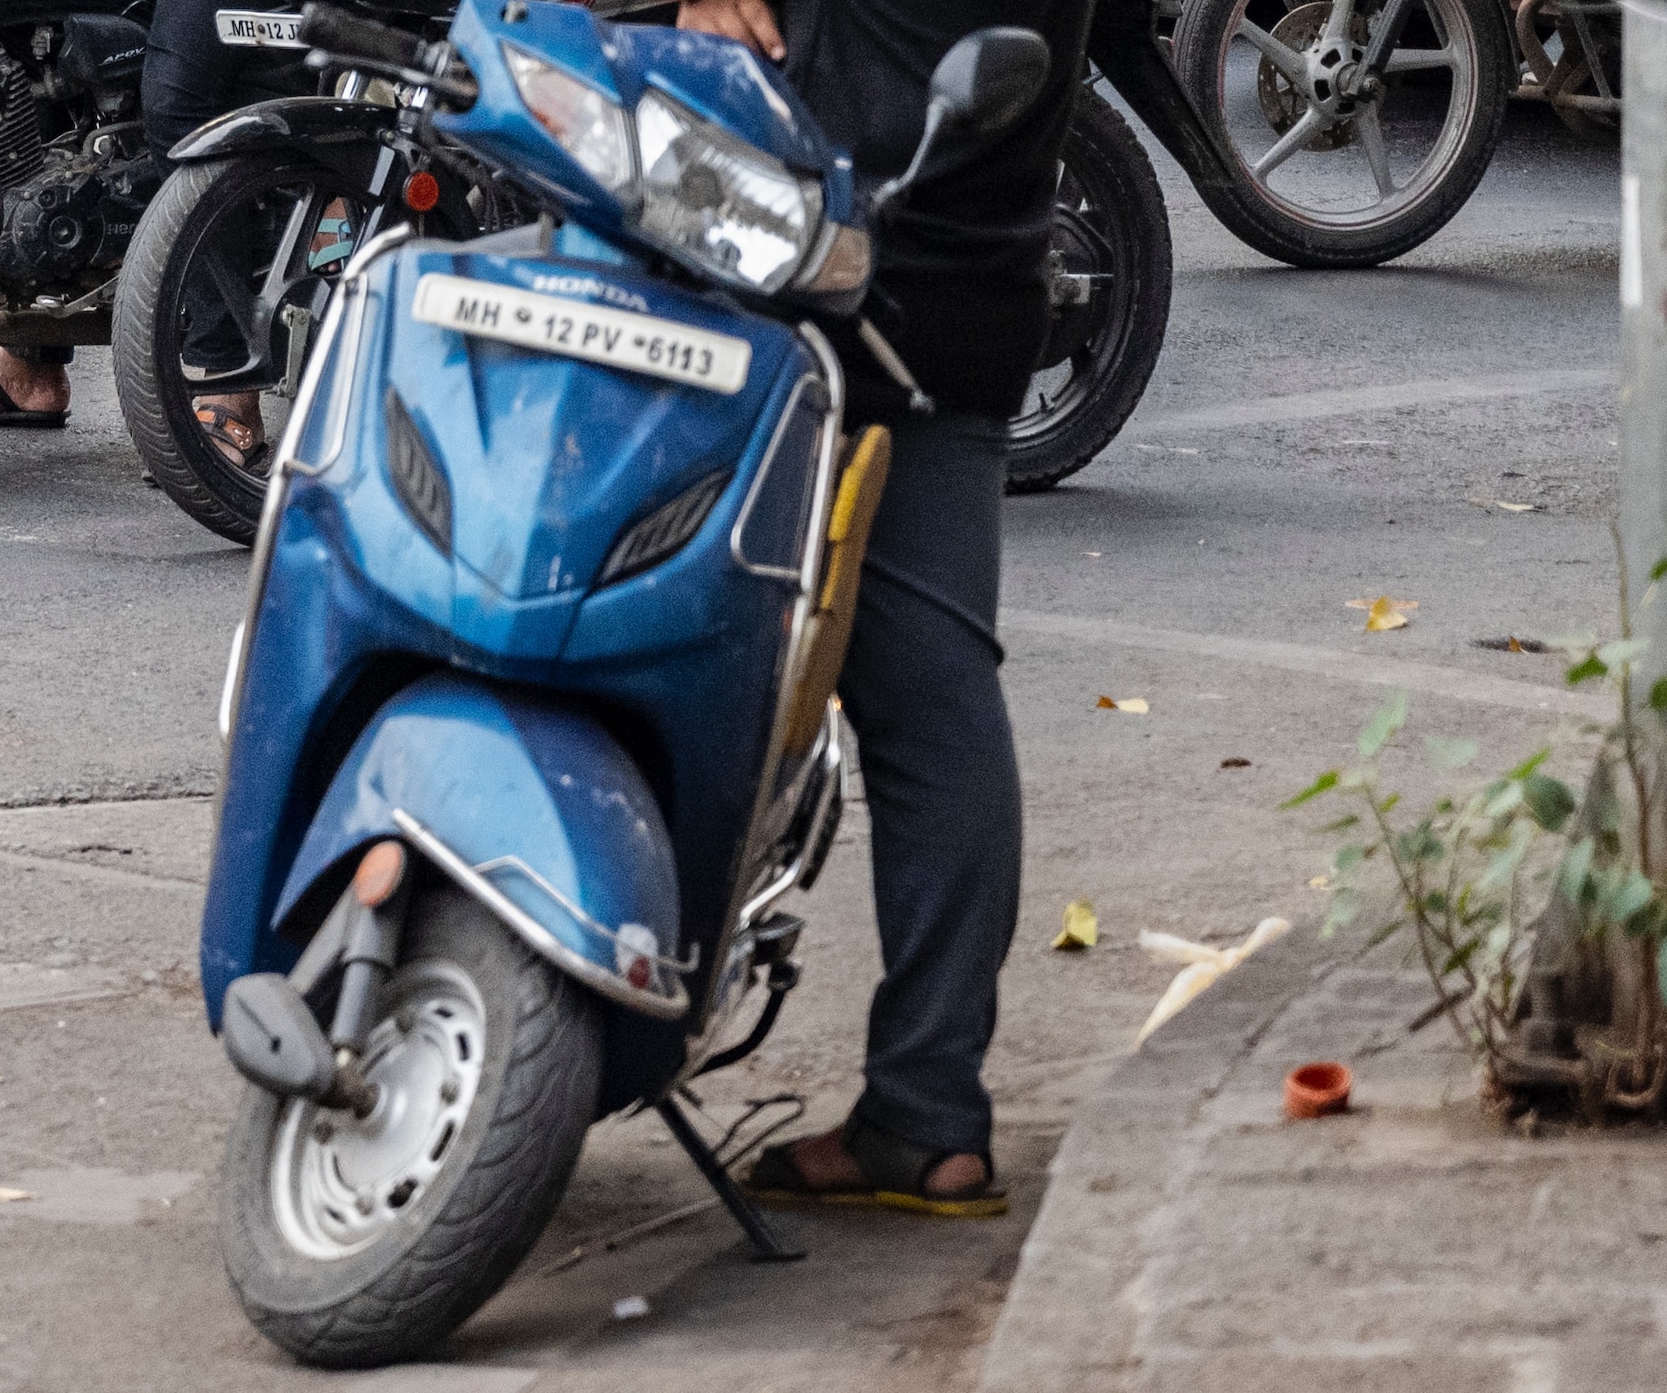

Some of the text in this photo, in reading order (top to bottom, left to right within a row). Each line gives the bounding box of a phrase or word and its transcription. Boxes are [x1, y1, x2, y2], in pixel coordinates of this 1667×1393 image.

[230, 19, 257, 39] MH
[266, 21, 284, 39] 12
[532, 273, 650, 314] HONDA
[454, 295, 501, 328] MH
[543, 316, 573, 344] 12
[581, 322, 625, 355] PV
